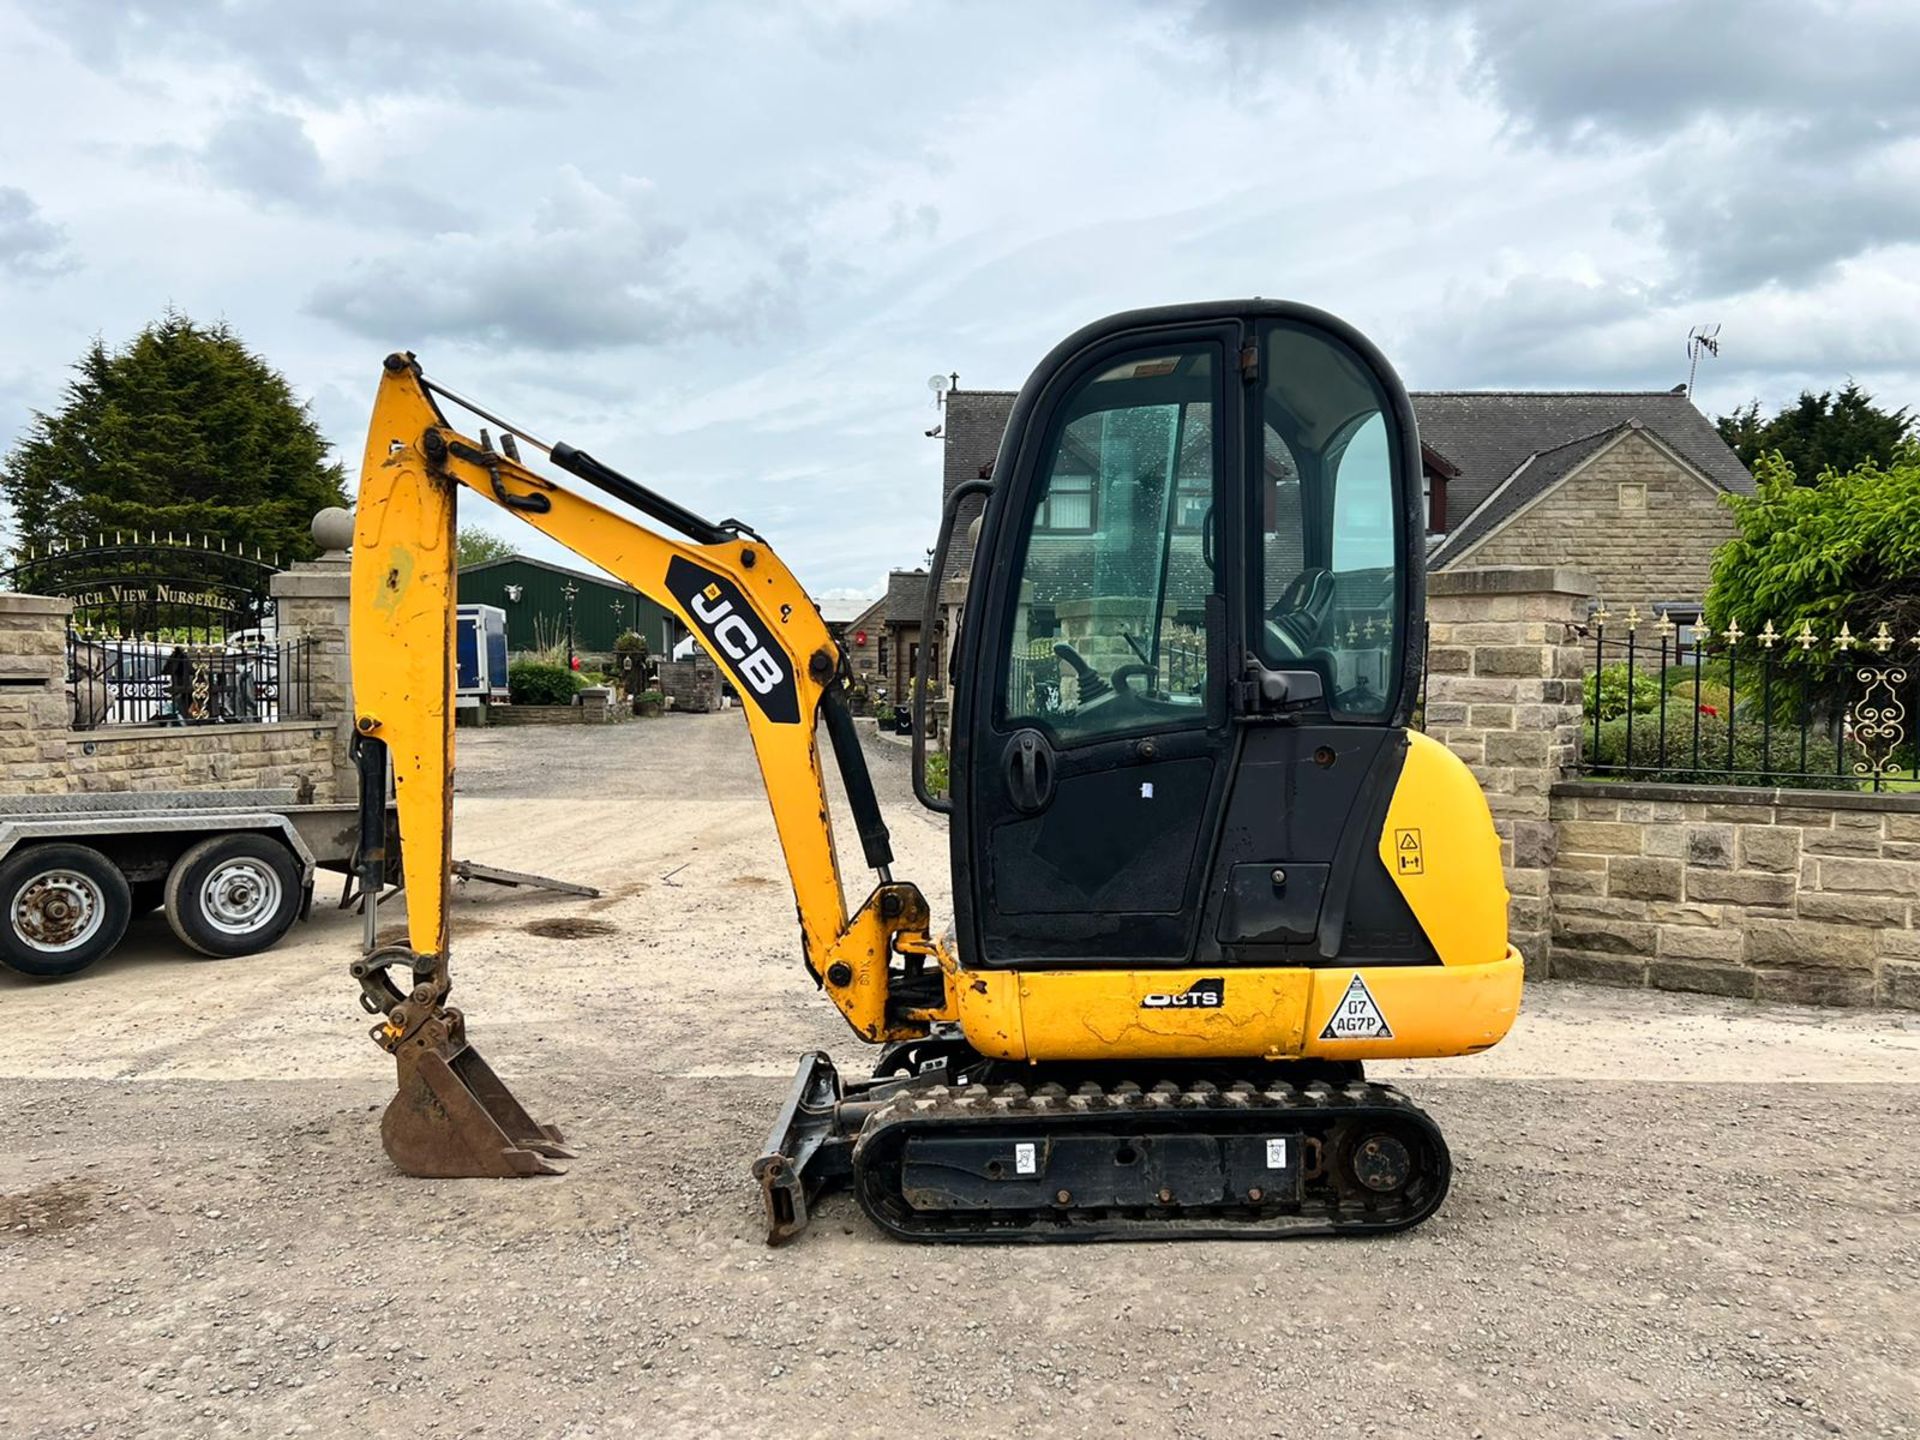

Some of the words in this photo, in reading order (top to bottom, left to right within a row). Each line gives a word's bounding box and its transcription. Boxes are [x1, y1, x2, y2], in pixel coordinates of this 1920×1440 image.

[110, 585, 149, 603] VIEW
[157, 585, 236, 611] NURSERIES
[690, 592, 784, 695] JCB
[1336, 1017, 1376, 1031] AG7P
